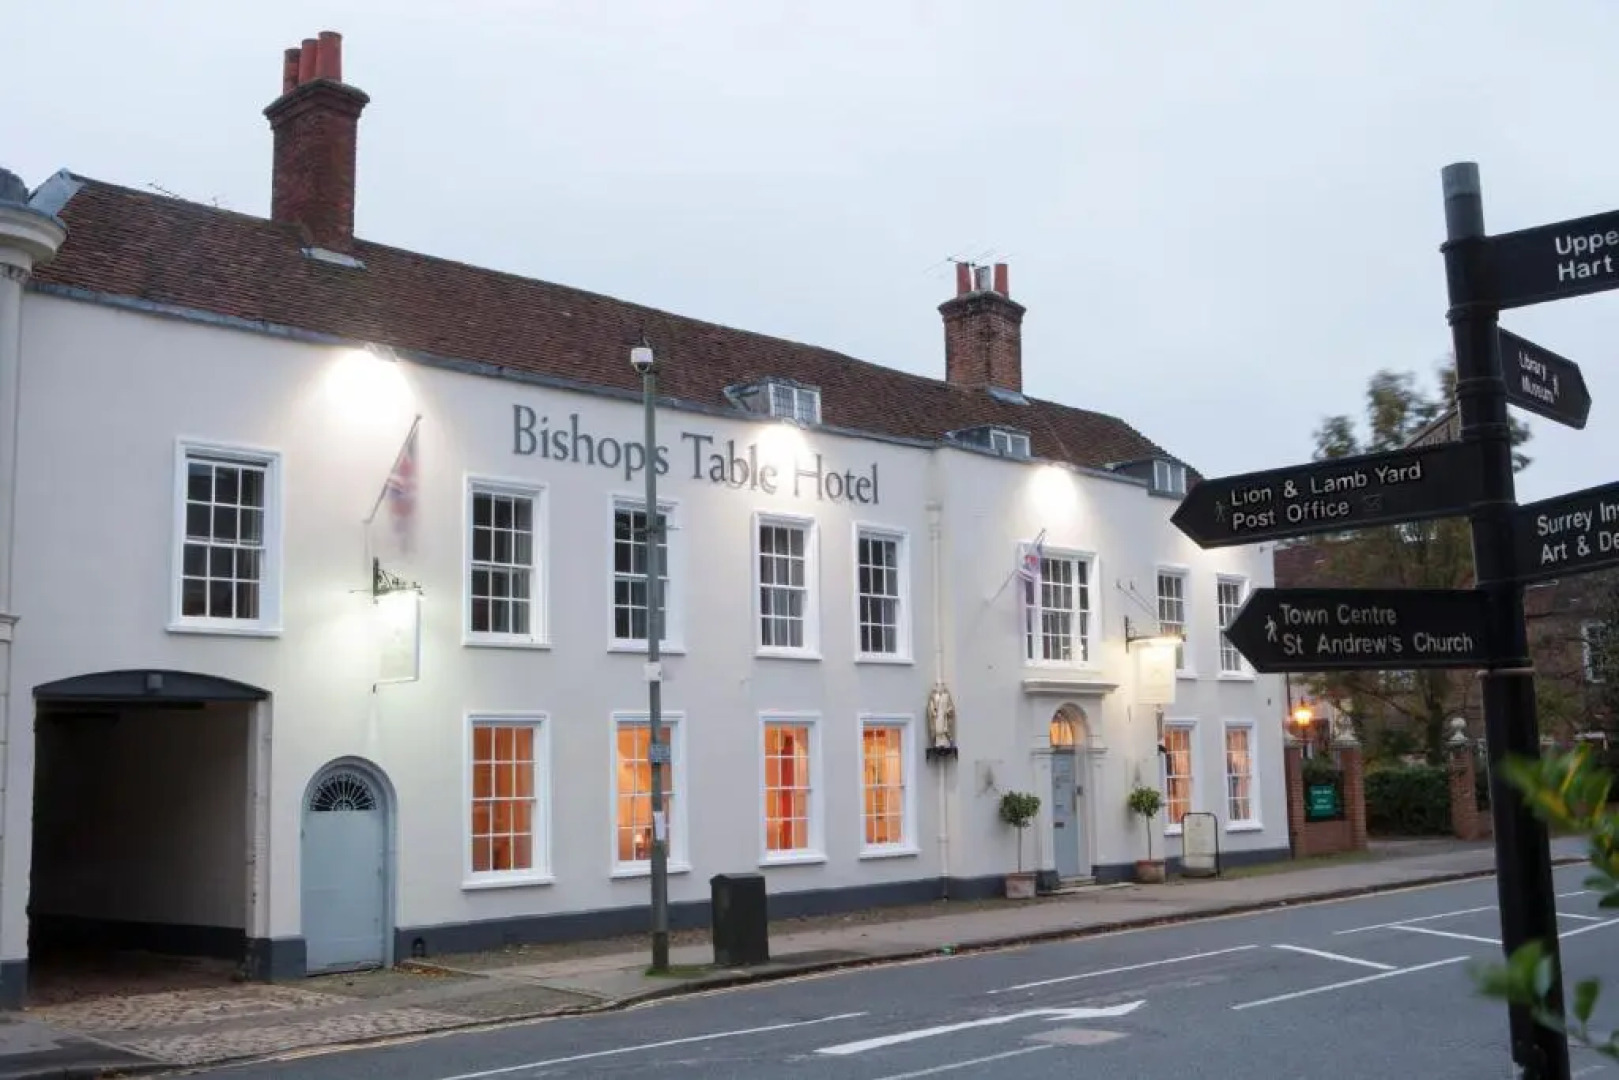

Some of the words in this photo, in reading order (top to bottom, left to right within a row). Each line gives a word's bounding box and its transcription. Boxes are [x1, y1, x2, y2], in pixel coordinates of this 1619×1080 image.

[1558, 254, 1614, 282] Hart
[681, 431, 779, 496] Table
[793, 453, 880, 505] Hotel
[1231, 486, 1272, 507] Lion
[1284, 480, 1299, 499] &
[1311, 470, 1368, 494] Lamb
[1374, 461, 1421, 485] Yard
[1232, 509, 1277, 531] Post
[1286, 500, 1350, 523] Office
[1537, 506, 1593, 537] Surrey
[1600, 502, 1619, 523] In
[1541, 540, 1568, 566] Art
[1577, 534, 1591, 557] &
[1280, 603, 1329, 625] Town
[1337, 603, 1397, 625] Centre
[1283, 633, 1304, 656] St
[1316, 632, 1403, 654] Andrew's
[1413, 631, 1473, 652] Church
